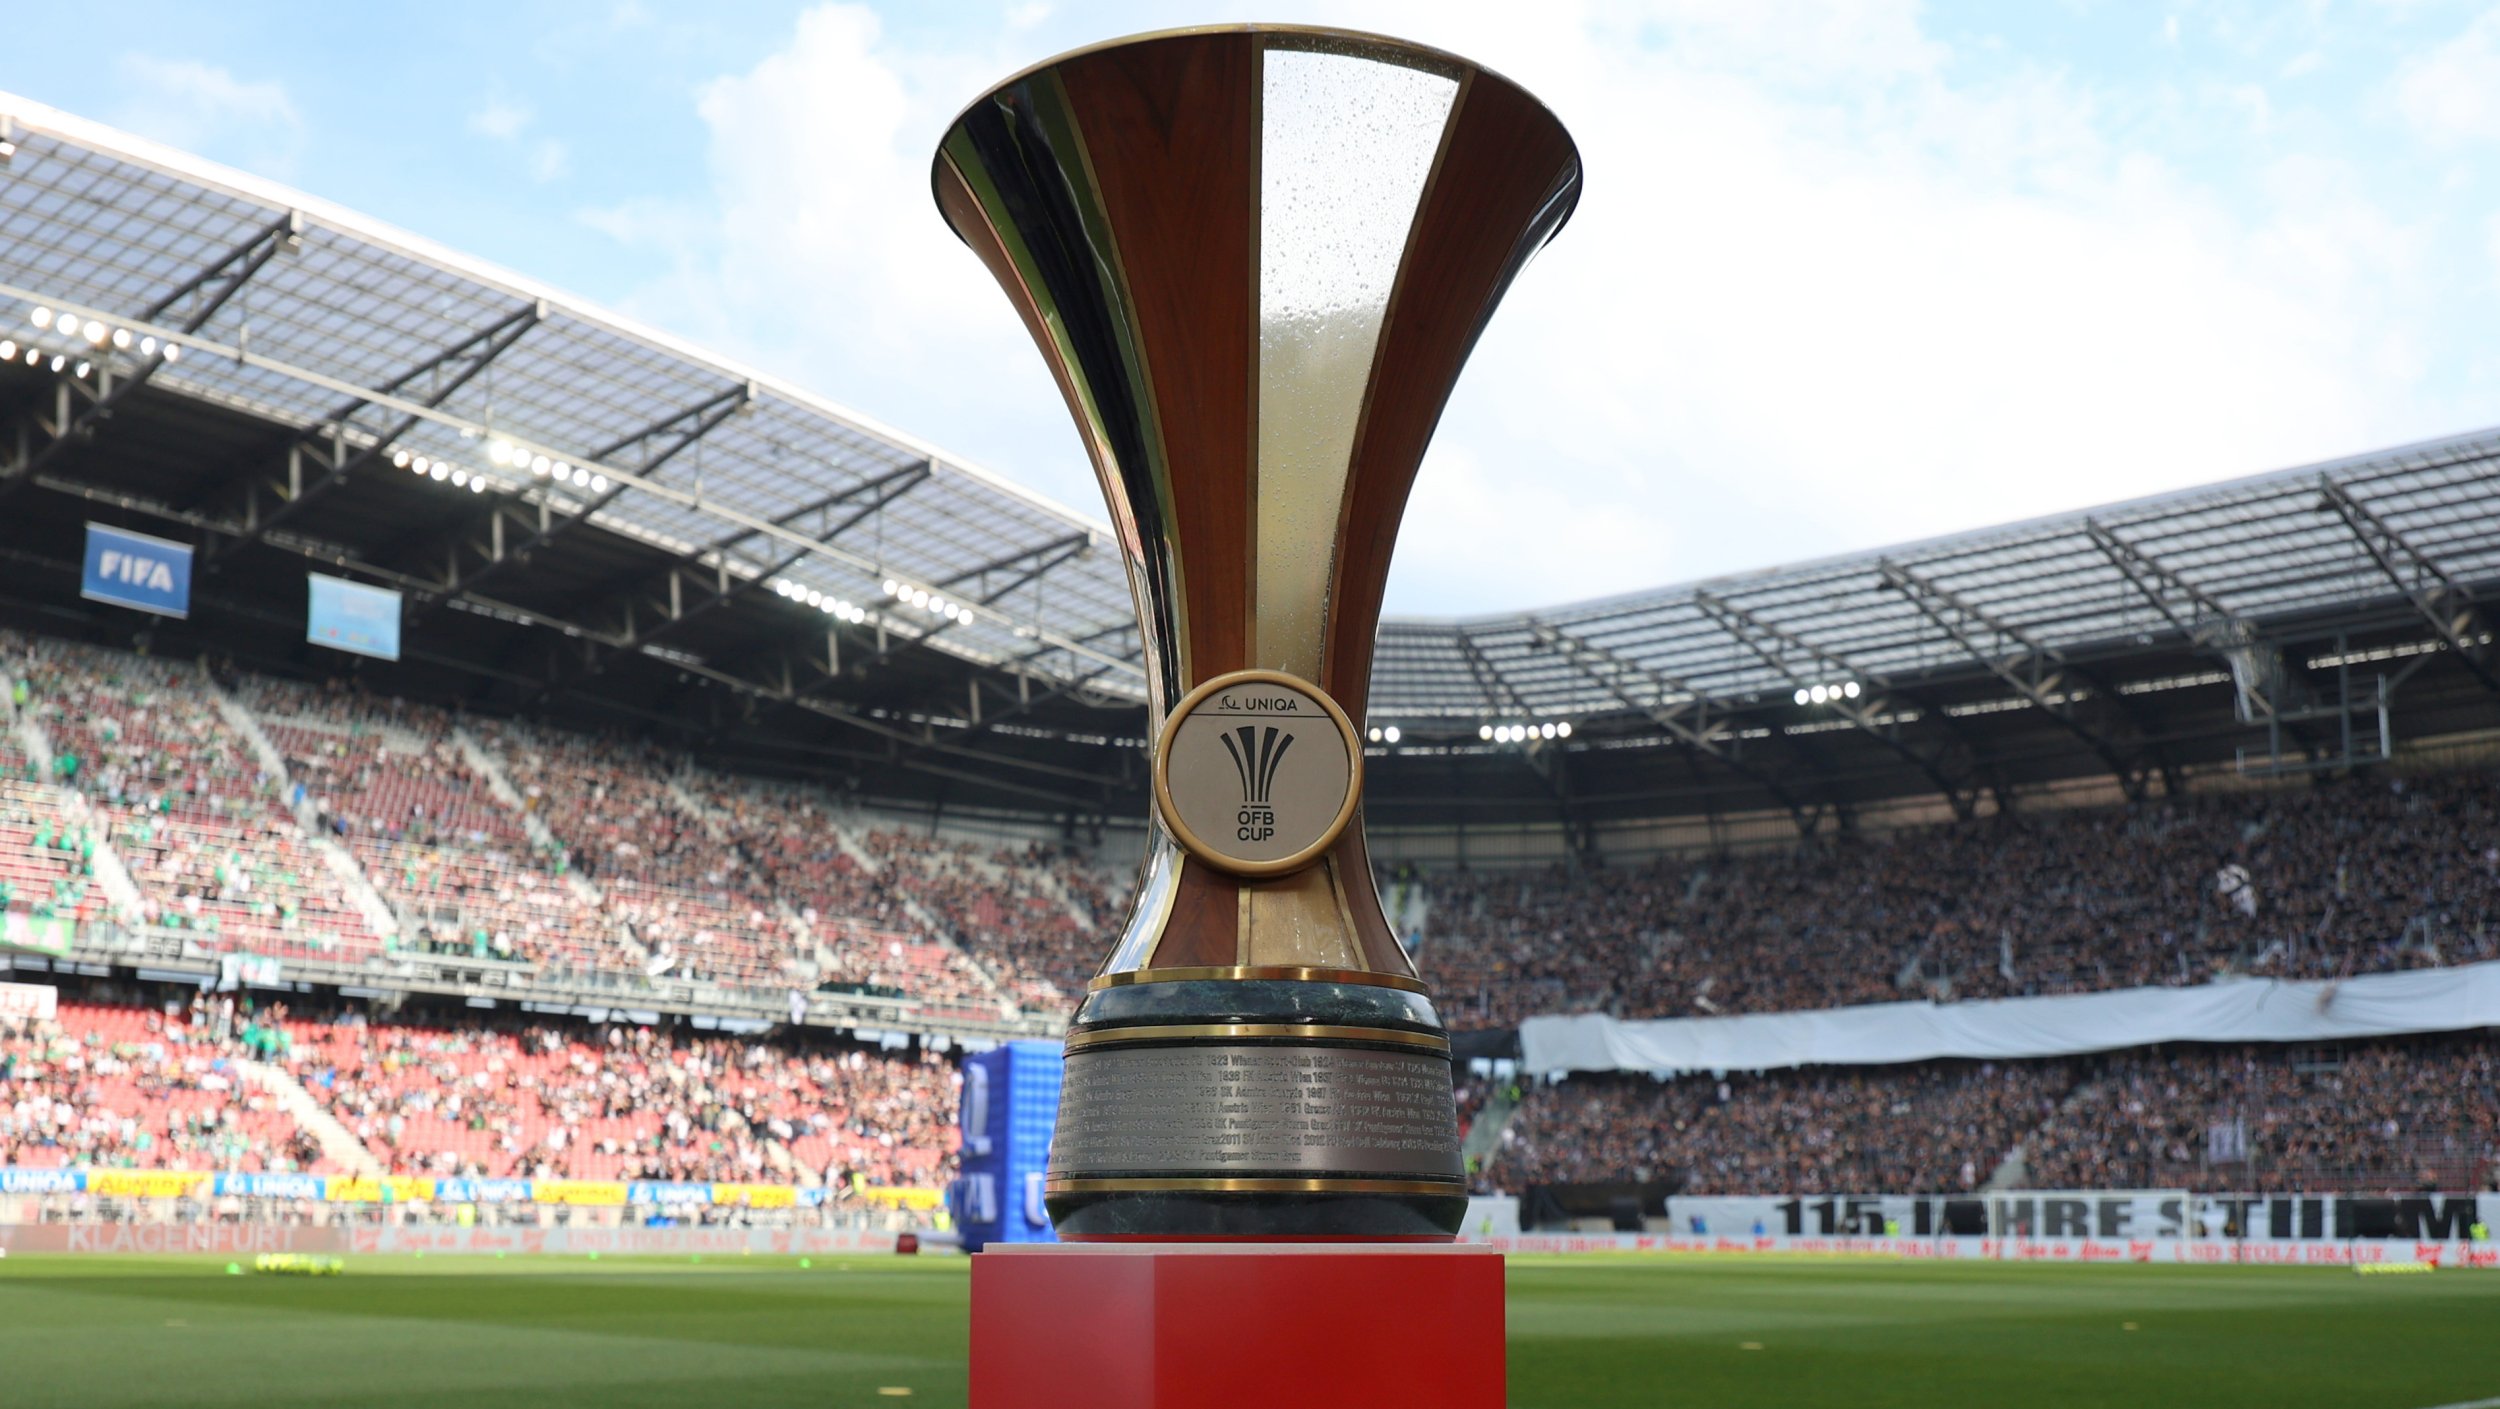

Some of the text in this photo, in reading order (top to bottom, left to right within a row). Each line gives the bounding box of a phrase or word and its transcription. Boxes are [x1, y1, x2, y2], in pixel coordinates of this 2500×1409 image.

[100, 550, 174, 593] FIFA
[1245, 698, 1298, 712] UNIQA
[1237, 827, 1275, 842] CUP
[1775, 1199, 1885, 1234] 115
[68, 1225, 296, 1253] KLAGENFURT
